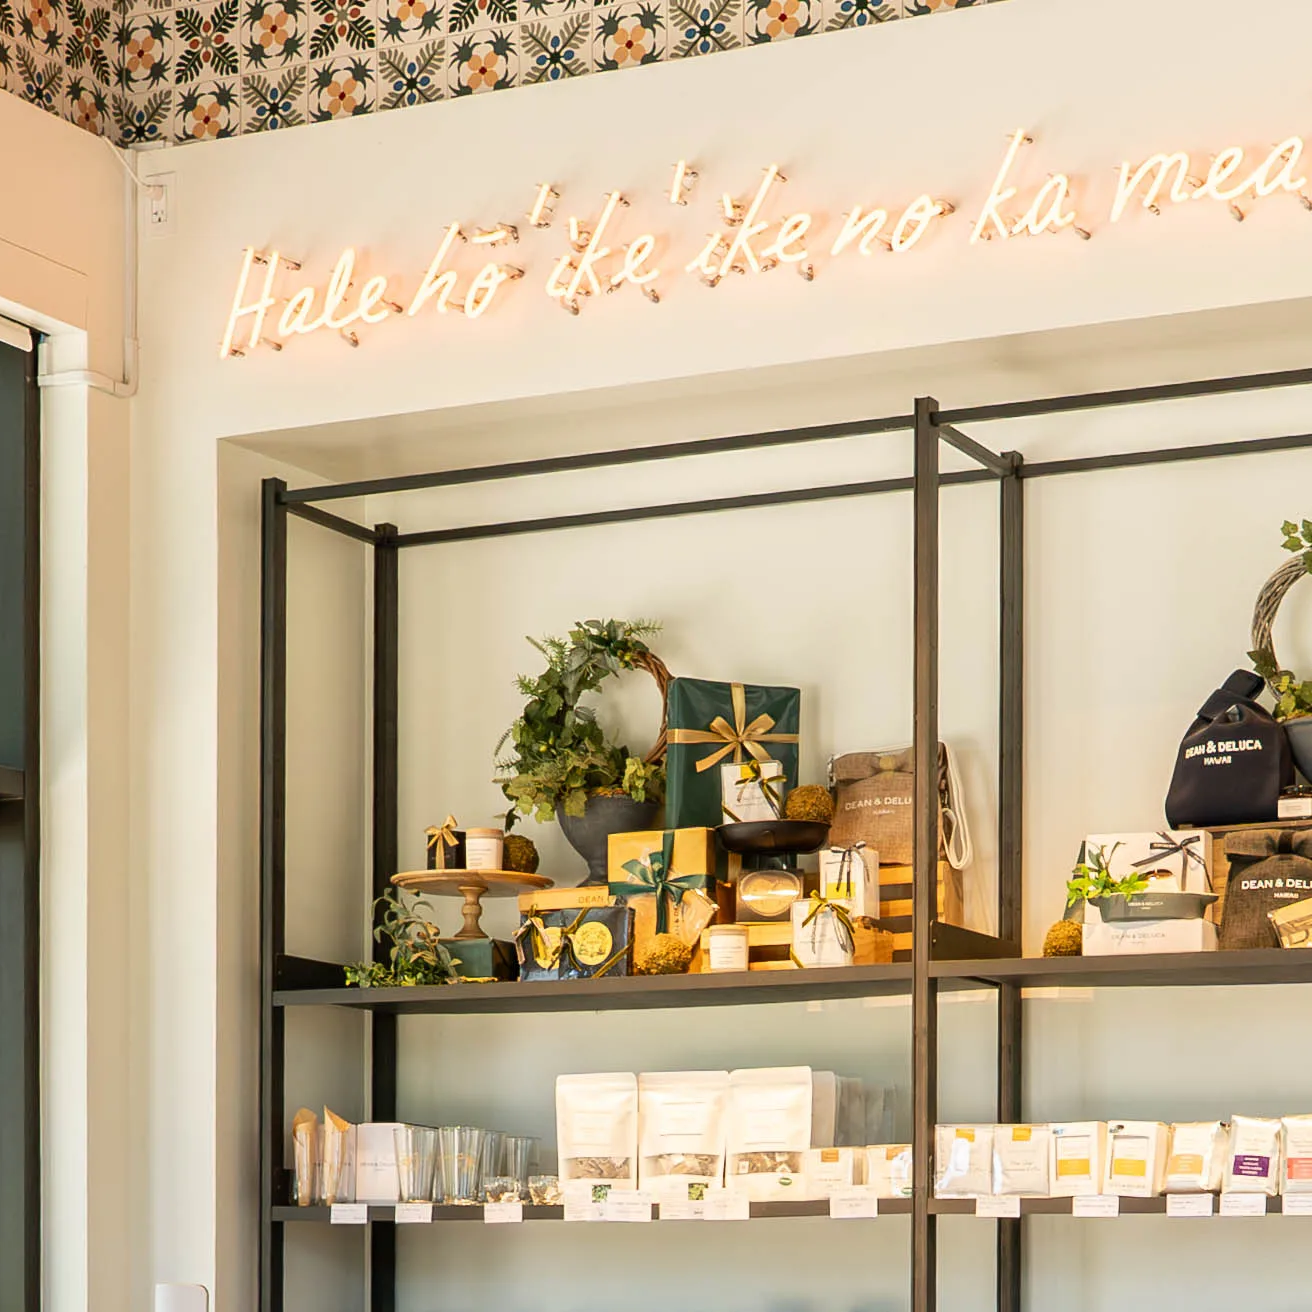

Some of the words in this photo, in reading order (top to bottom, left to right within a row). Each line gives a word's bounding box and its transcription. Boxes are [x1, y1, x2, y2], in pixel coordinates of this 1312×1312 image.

[219, 245, 389, 359] Hale
[830, 192, 946, 257] no
[969, 127, 1076, 246] ka
[1206, 740, 1217, 754] &
[1218, 739, 1263, 753] DELUCA
[844, 799, 872, 811] DEAN
[874, 798, 883, 807] &
[884, 795, 913, 806] DELU
[1241, 879, 1274, 891] DEAN
[1275, 878, 1284, 889] &
